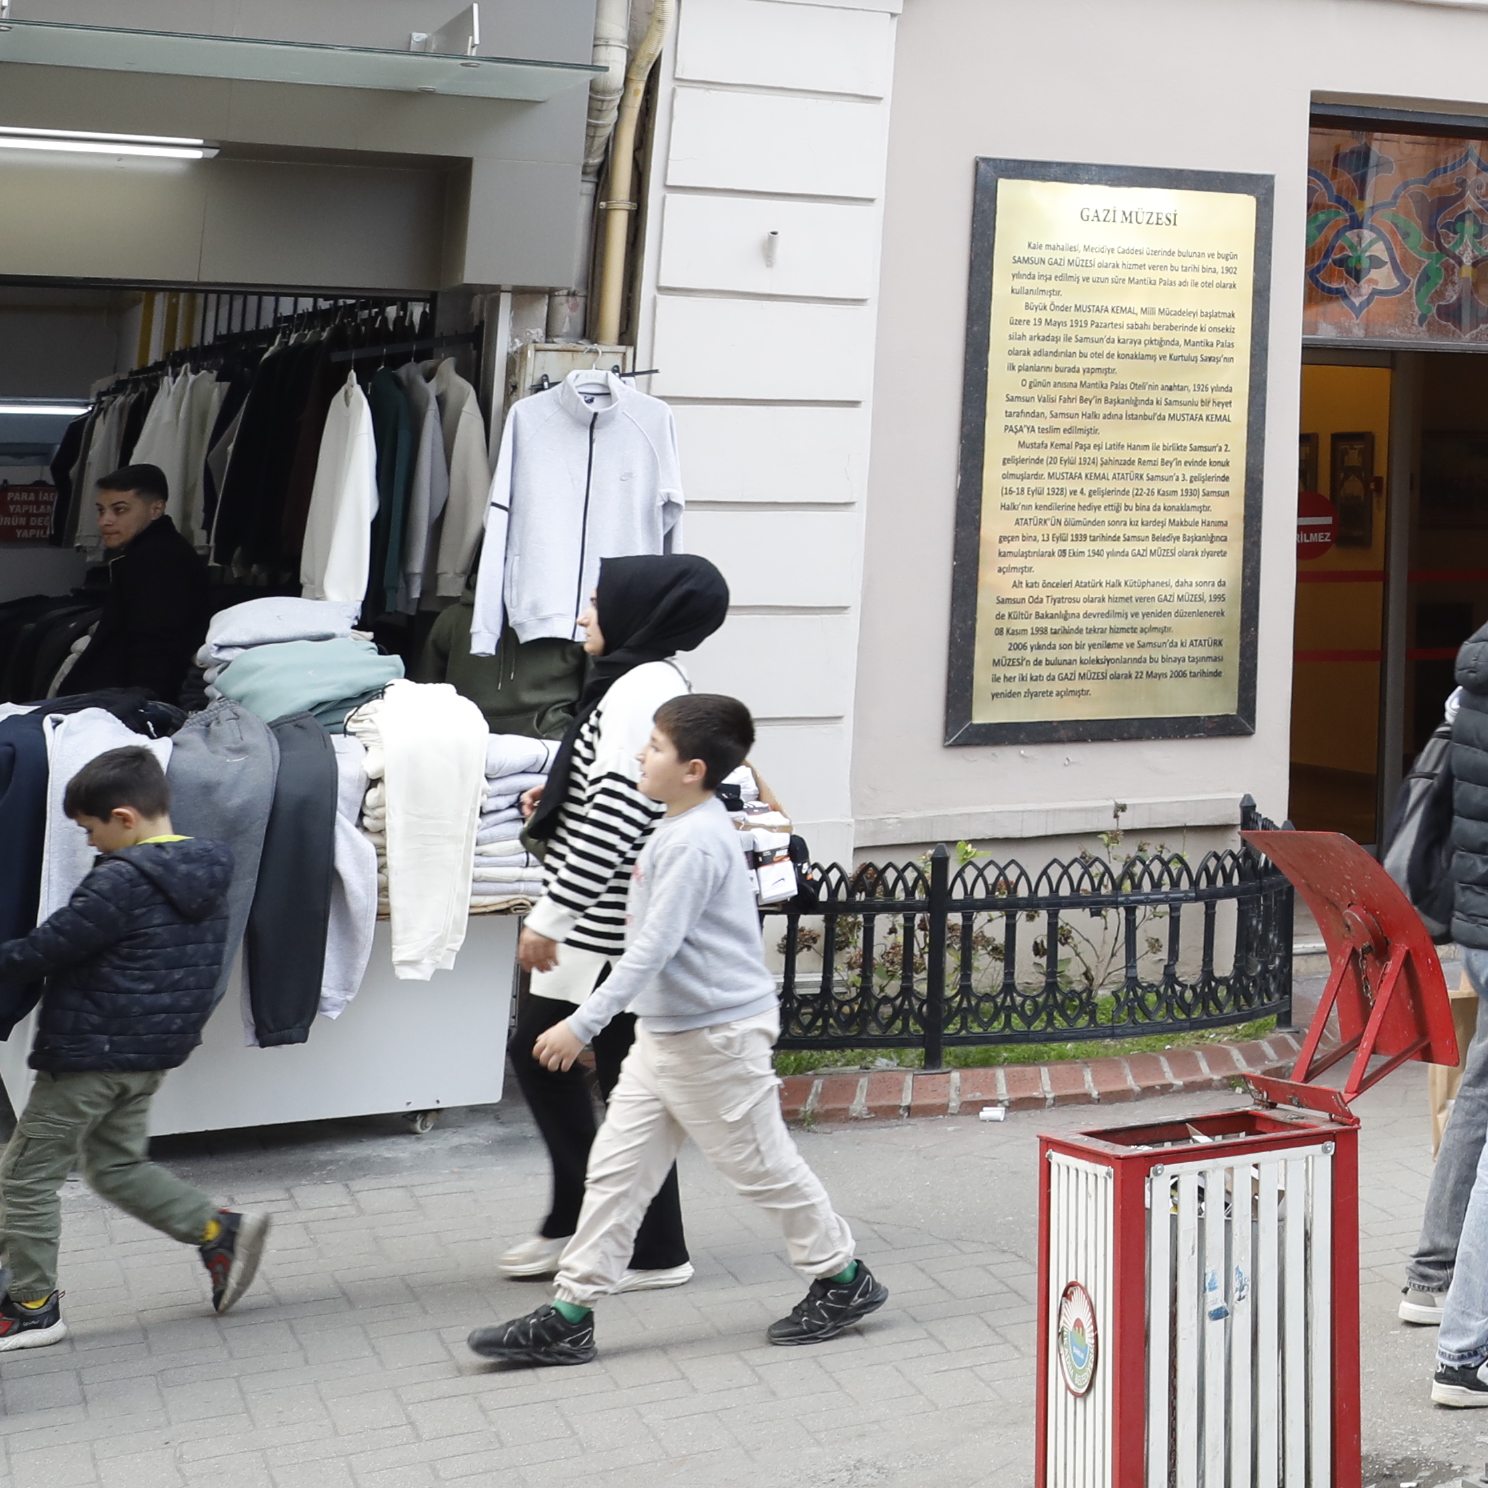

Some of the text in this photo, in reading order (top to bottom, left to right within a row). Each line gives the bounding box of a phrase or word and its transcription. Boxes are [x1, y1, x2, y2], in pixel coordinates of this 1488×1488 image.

[1080, 204, 1177, 226] GAZİ MÜZESİ
[1009, 316, 1030, 325] üzere
[1033, 317, 1042, 326] 19
[1044, 317, 1067, 329] Mayıs
[1069, 319, 1088, 328] 1919
[1090, 319, 1124, 329] Pazartesi
[1126, 321, 1150, 330] sabahı
[1199, 323, 1206, 332] ki
[1207, 324, 1235, 333] onsekiz
[1049, 410, 1079, 419] Samsun
[1081, 410, 1100, 419] Halkı
[1102, 411, 1123, 420] adına
[1167, 412, 1203, 421] MUSTAFA
[1205, 413, 1231, 422] KEMAL
[1037, 425, 1060, 434] teslim
